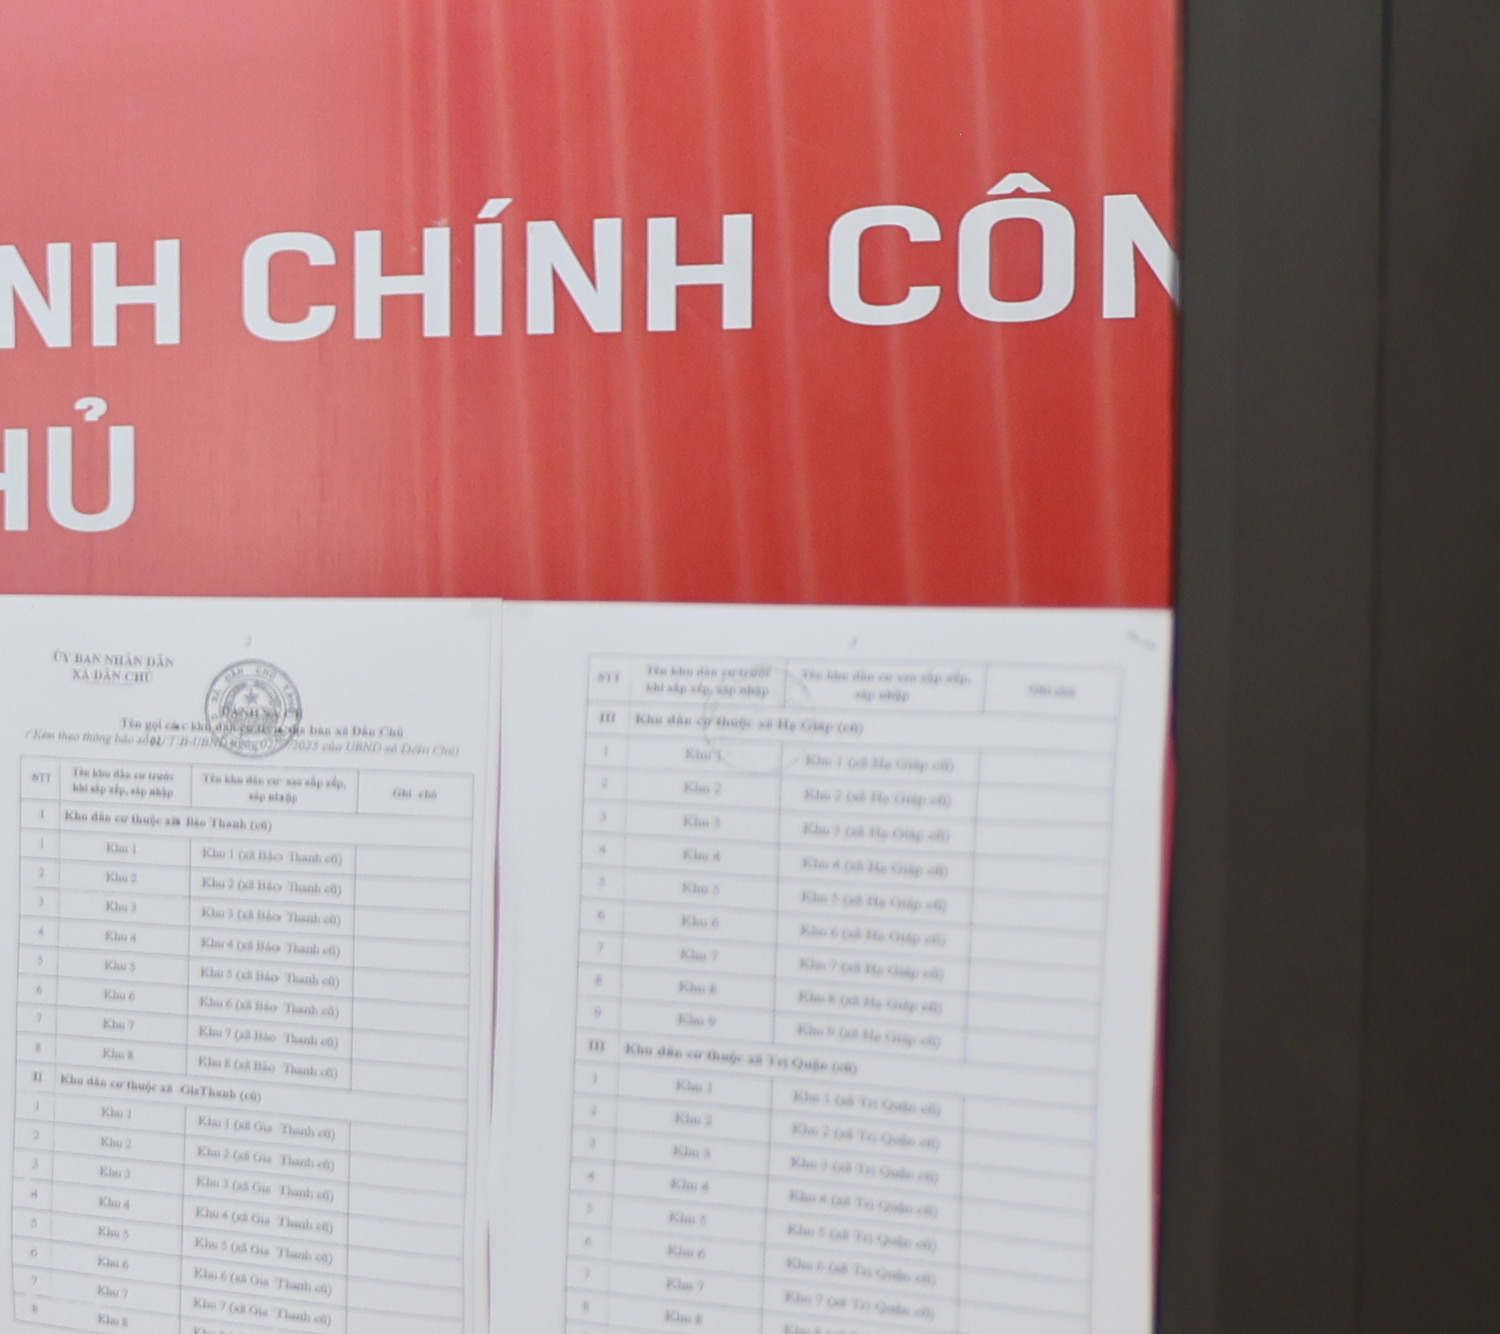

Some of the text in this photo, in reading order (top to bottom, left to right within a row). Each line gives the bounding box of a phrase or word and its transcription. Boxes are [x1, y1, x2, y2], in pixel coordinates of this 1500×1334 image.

[240, 198, 754, 340] CHÍNH
[75, 652, 101, 664] BAN
[105, 652, 142, 666] NHÂN
[147, 653, 174, 668] DÂN
[94, 668, 121, 681] DÂN
